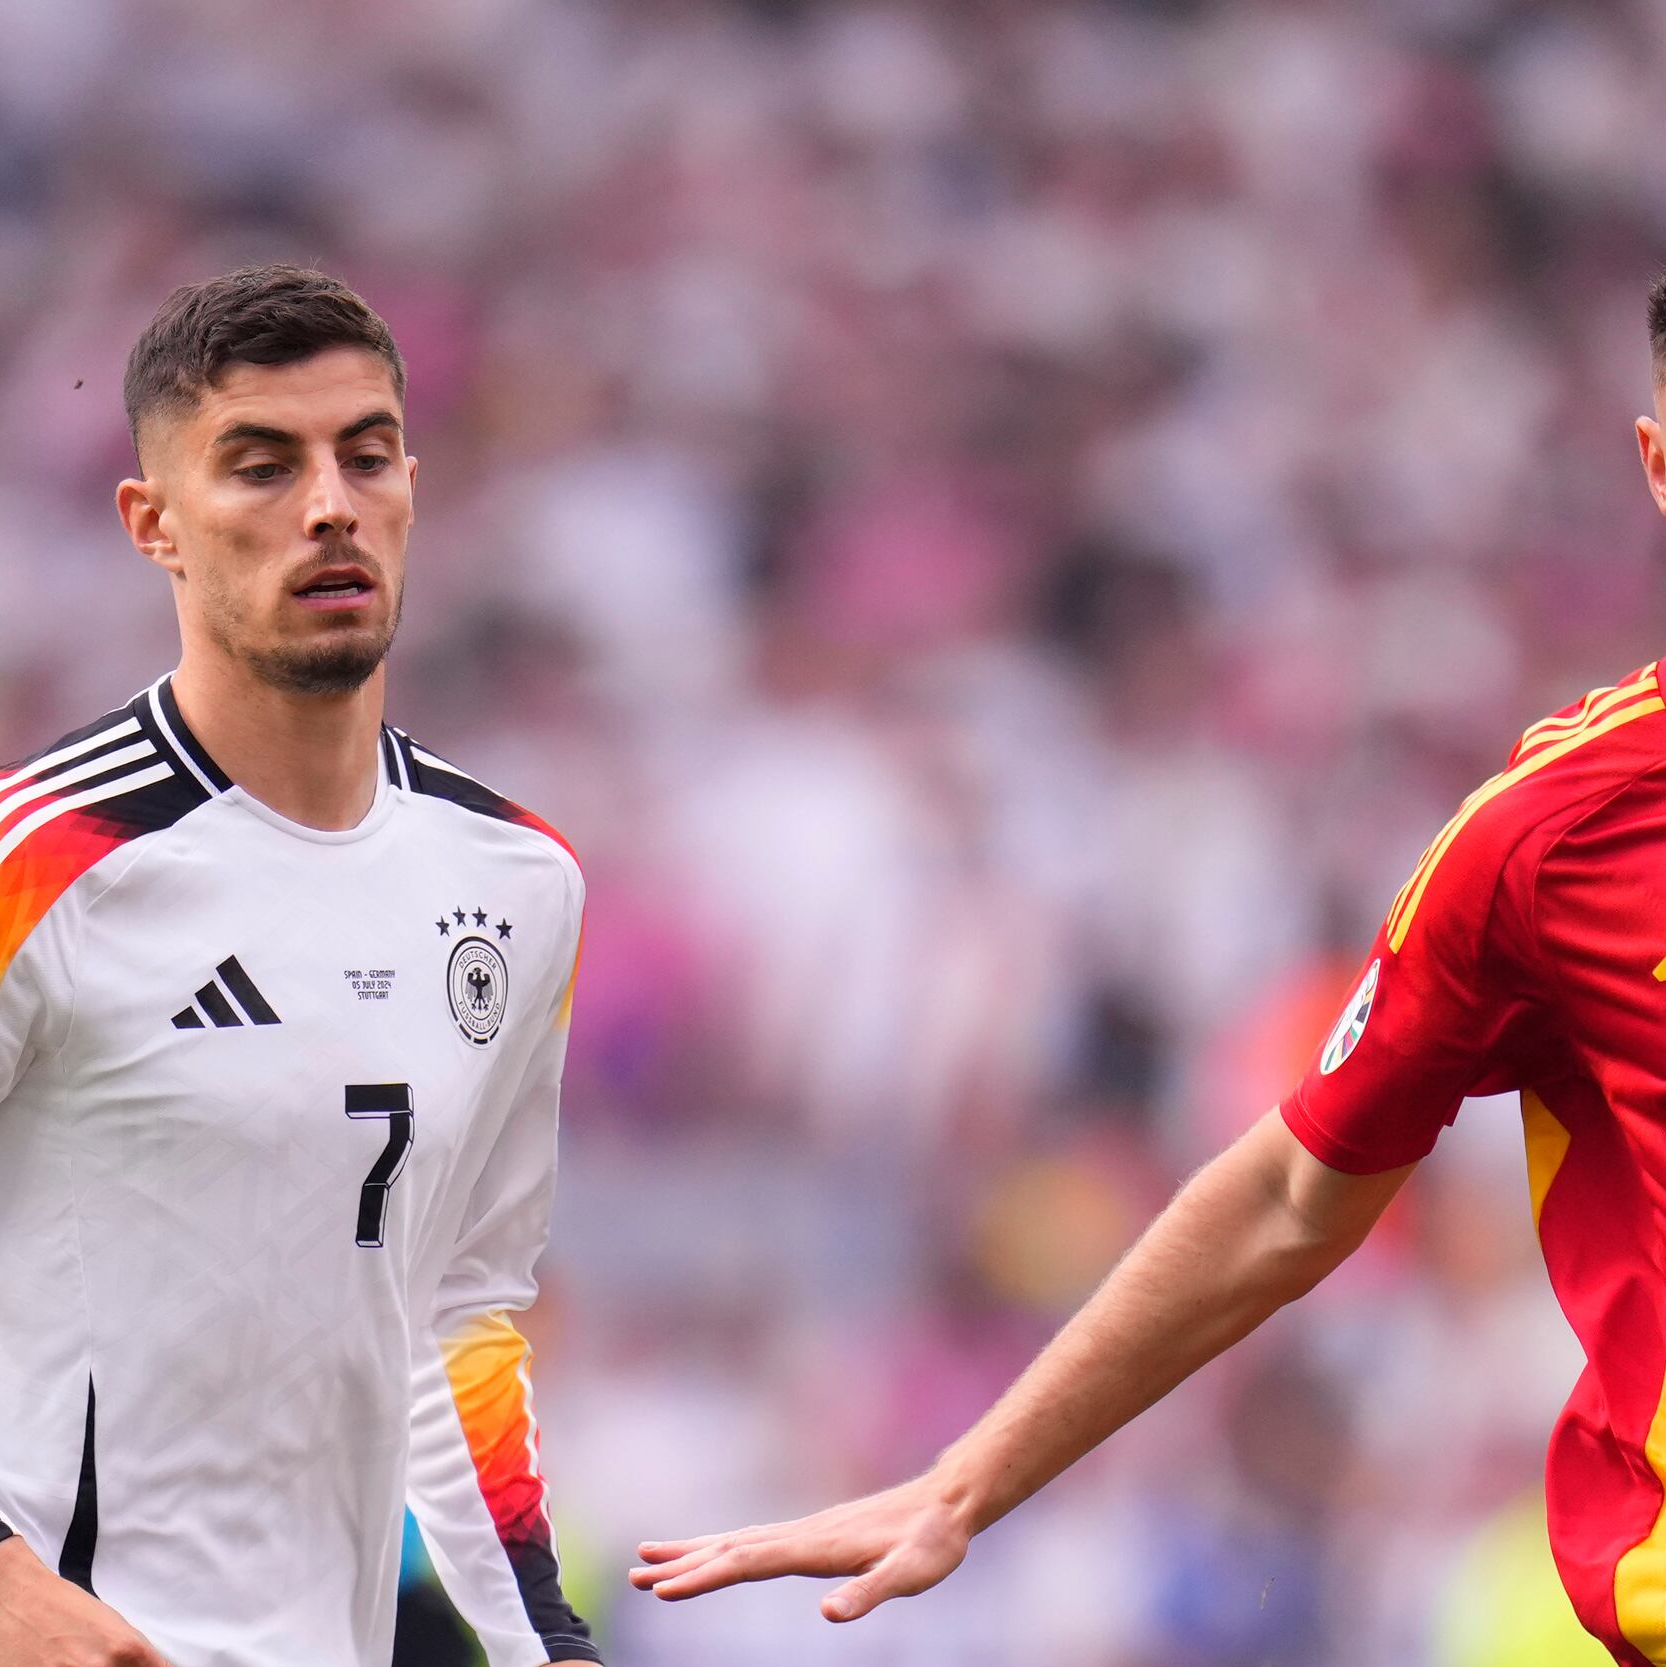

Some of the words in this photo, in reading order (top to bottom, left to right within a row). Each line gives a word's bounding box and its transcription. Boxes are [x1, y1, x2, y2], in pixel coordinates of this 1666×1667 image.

[459, 950, 498, 971] DEUTSCHER
[344, 970, 362, 979] SPAIN
[369, 970, 396, 979] GERMANY
[352, 981, 360, 989] 05
[362, 981, 376, 989] JULY
[377, 981, 391, 989] 2024
[358, 991, 389, 1000] STUTTGART
[345, 1083, 415, 1247] 7
